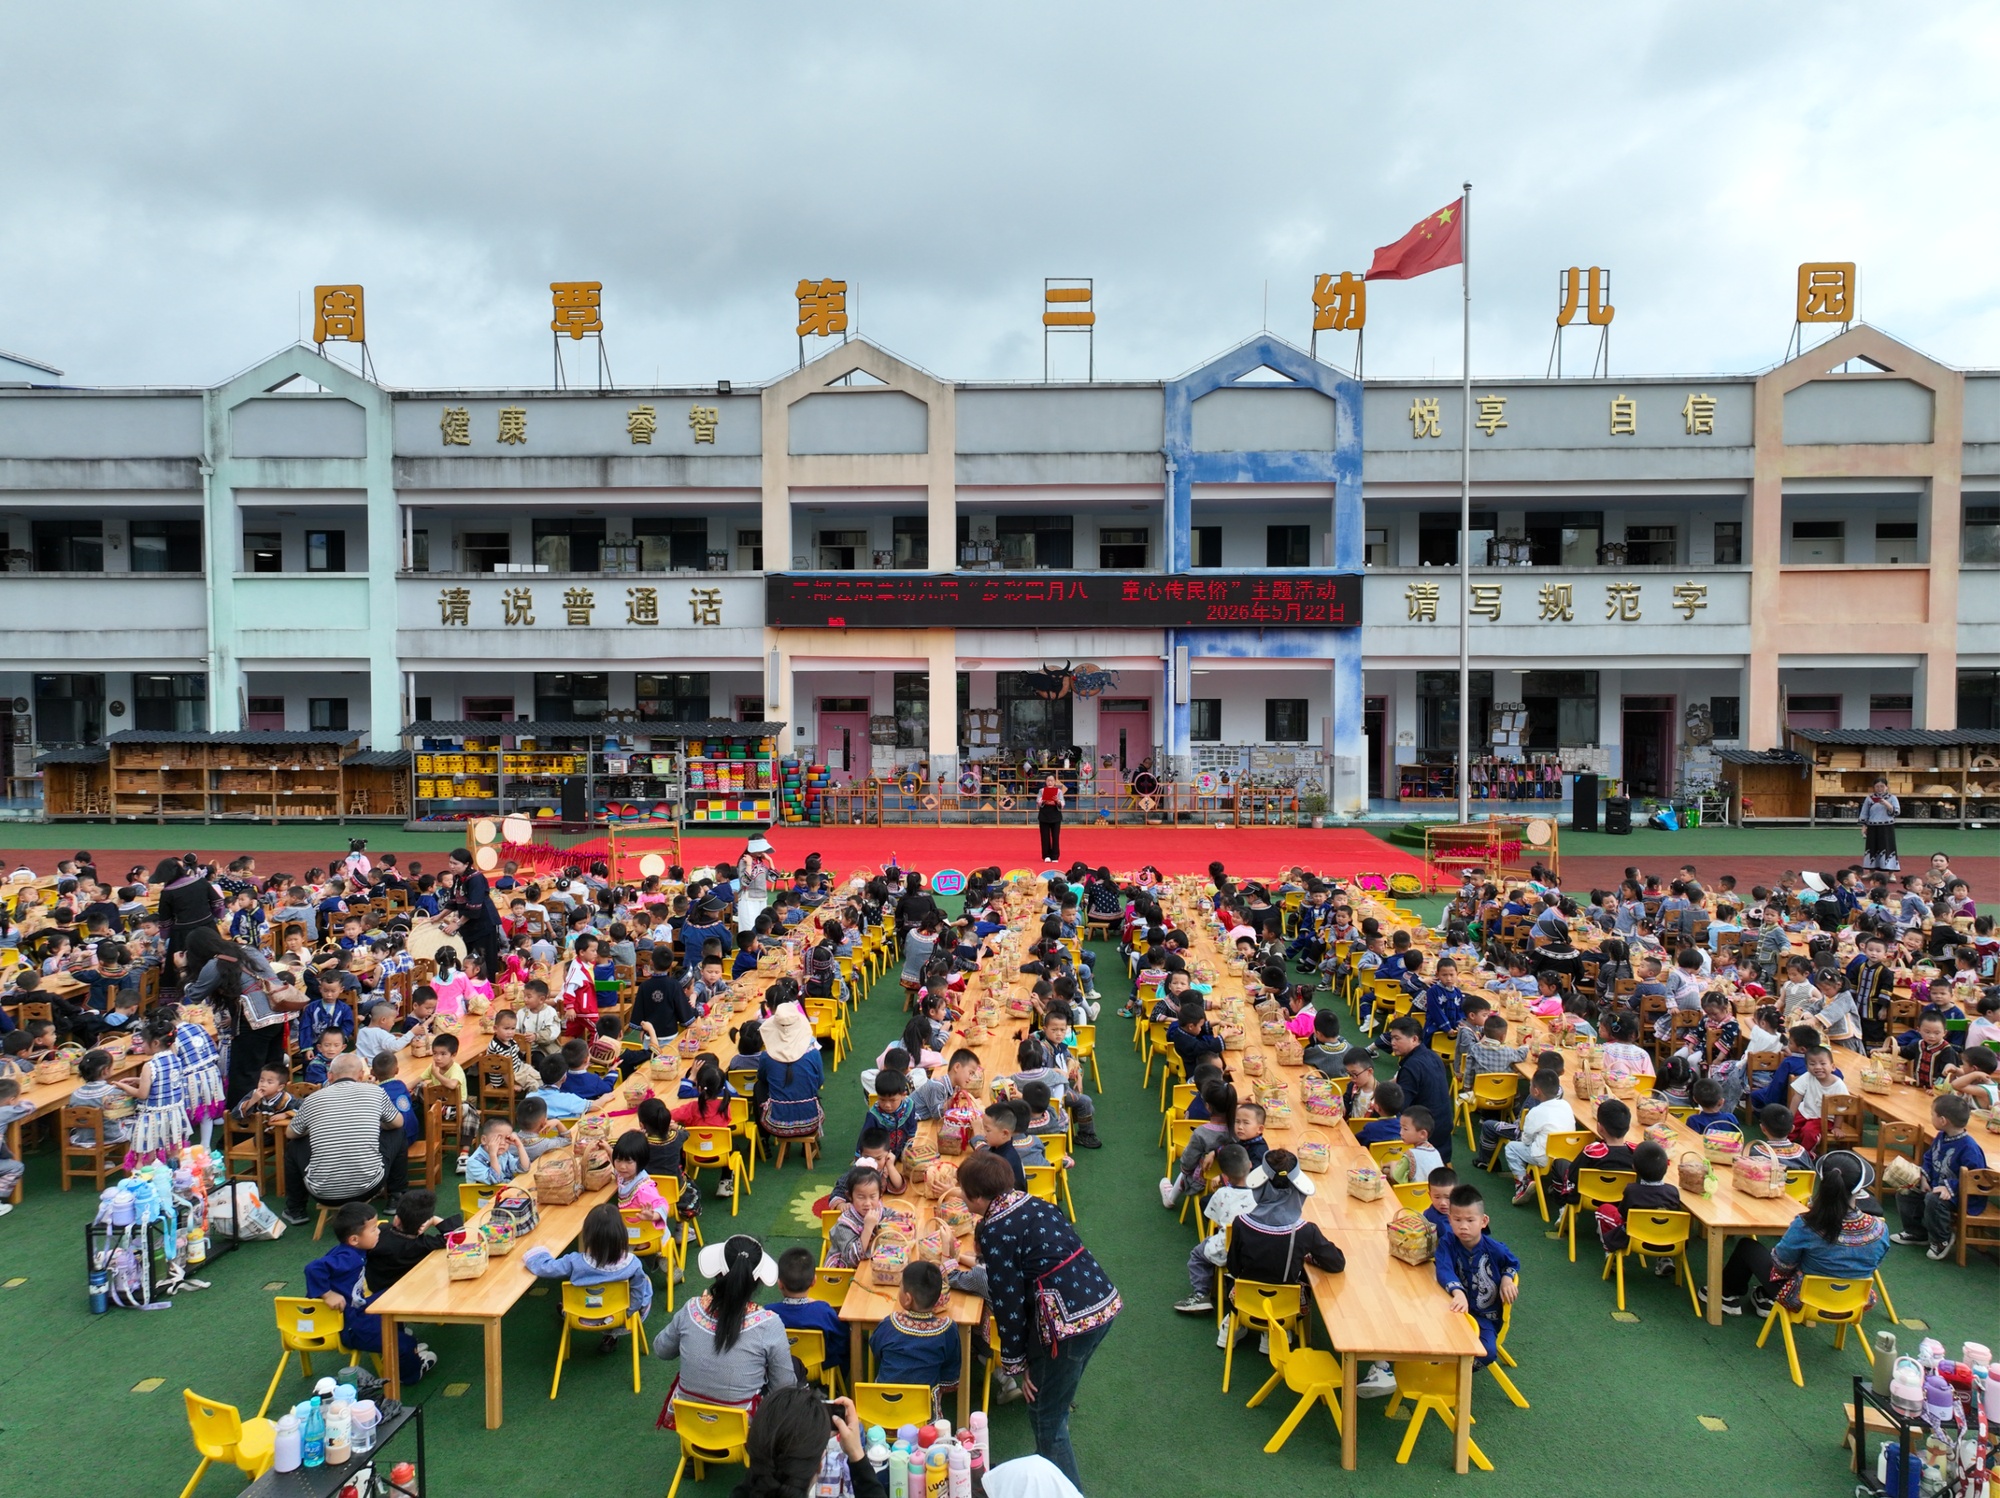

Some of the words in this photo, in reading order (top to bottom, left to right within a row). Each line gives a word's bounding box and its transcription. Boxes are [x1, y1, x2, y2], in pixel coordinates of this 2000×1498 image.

[313, 262, 1855, 343] 周覃第二幼儿园
[440, 405, 527, 446] 健康
[627, 404, 719, 444] 睿智
[1409, 393, 1508, 438] 悦享
[1610, 393, 1717, 435] 自信
[438, 586, 723, 626] 请说普通话
[1207, 602, 1345, 621] 2026年5月22日
[1404, 580, 1708, 622] 请写规范字
[937, 874, 960, 891] 四
